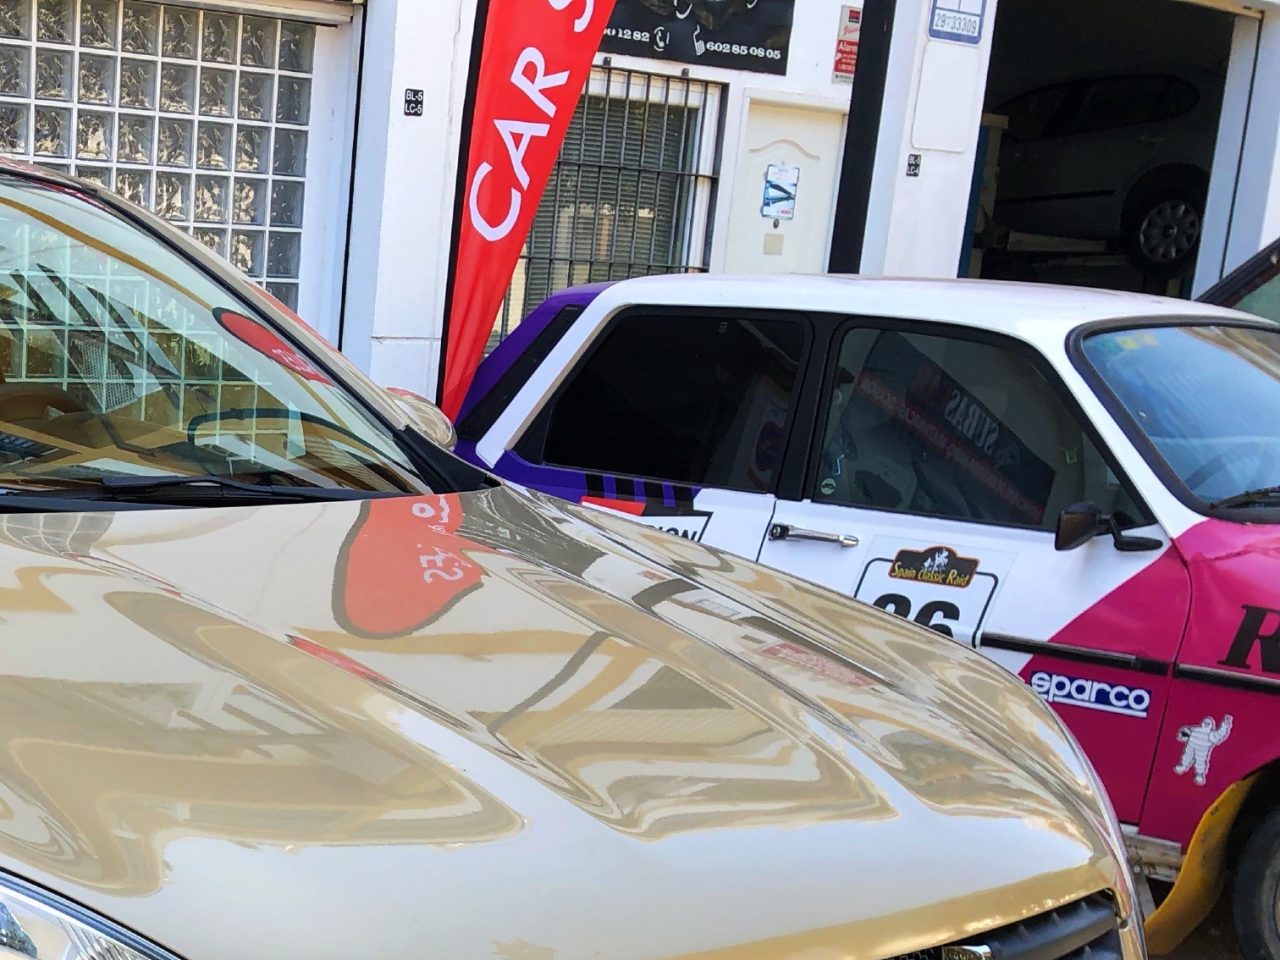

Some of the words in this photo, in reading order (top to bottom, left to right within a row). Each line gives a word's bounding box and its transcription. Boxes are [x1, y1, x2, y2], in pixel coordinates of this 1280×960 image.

[406, 90, 423, 101] BL-5
[405, 103, 422, 114] LC-5
[946, 569, 970, 587] Raid
[1031, 671, 1150, 711] sparco
